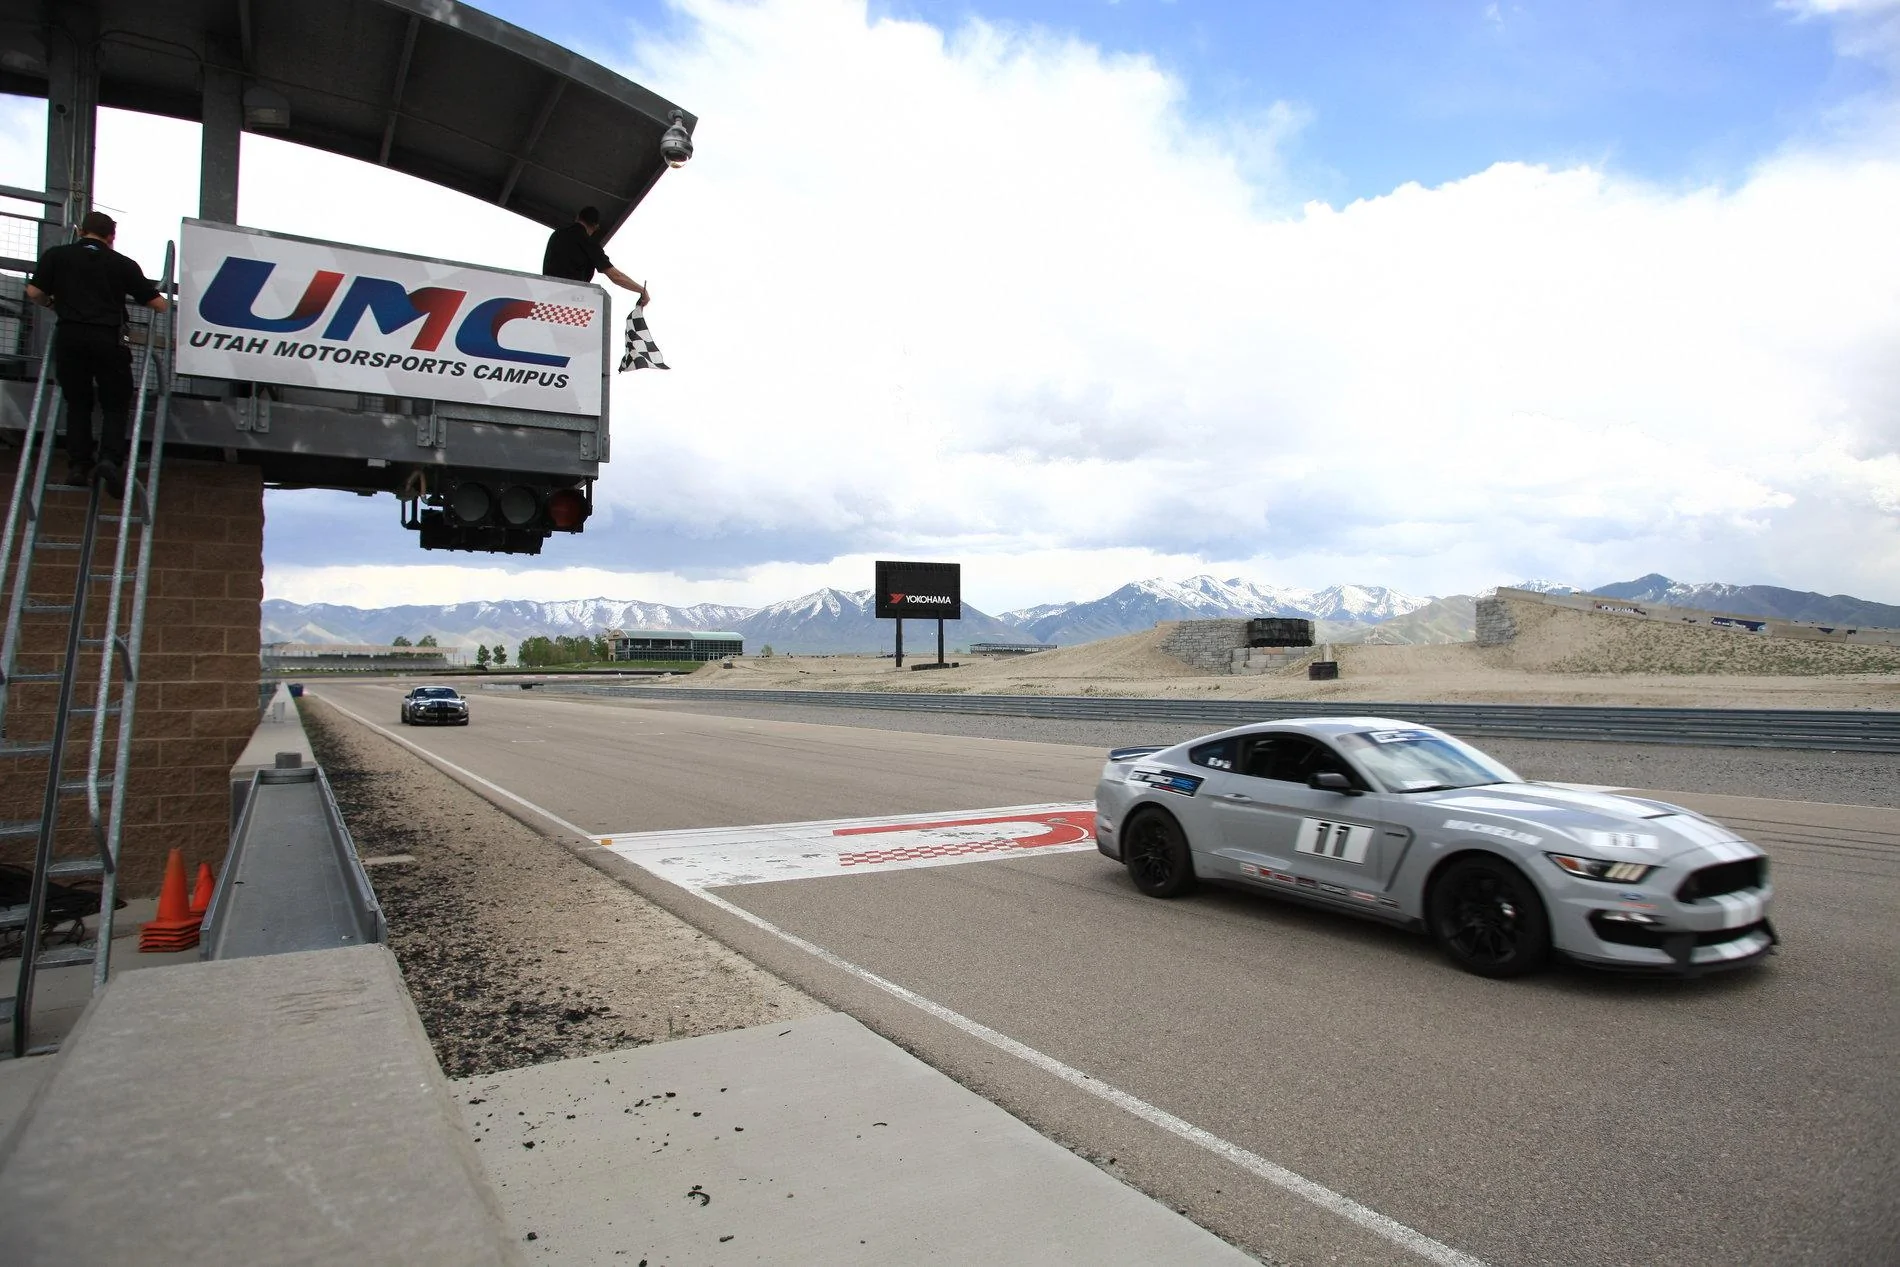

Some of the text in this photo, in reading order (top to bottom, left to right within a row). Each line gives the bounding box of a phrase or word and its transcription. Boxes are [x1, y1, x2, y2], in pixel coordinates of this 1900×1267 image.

[199, 256, 595, 368] UMC
[189, 330, 570, 389] UTAH MOTORSPORTS CAMPUS
[906, 595, 951, 604] YOKOHAMA
[1313, 822, 1352, 858] 11
